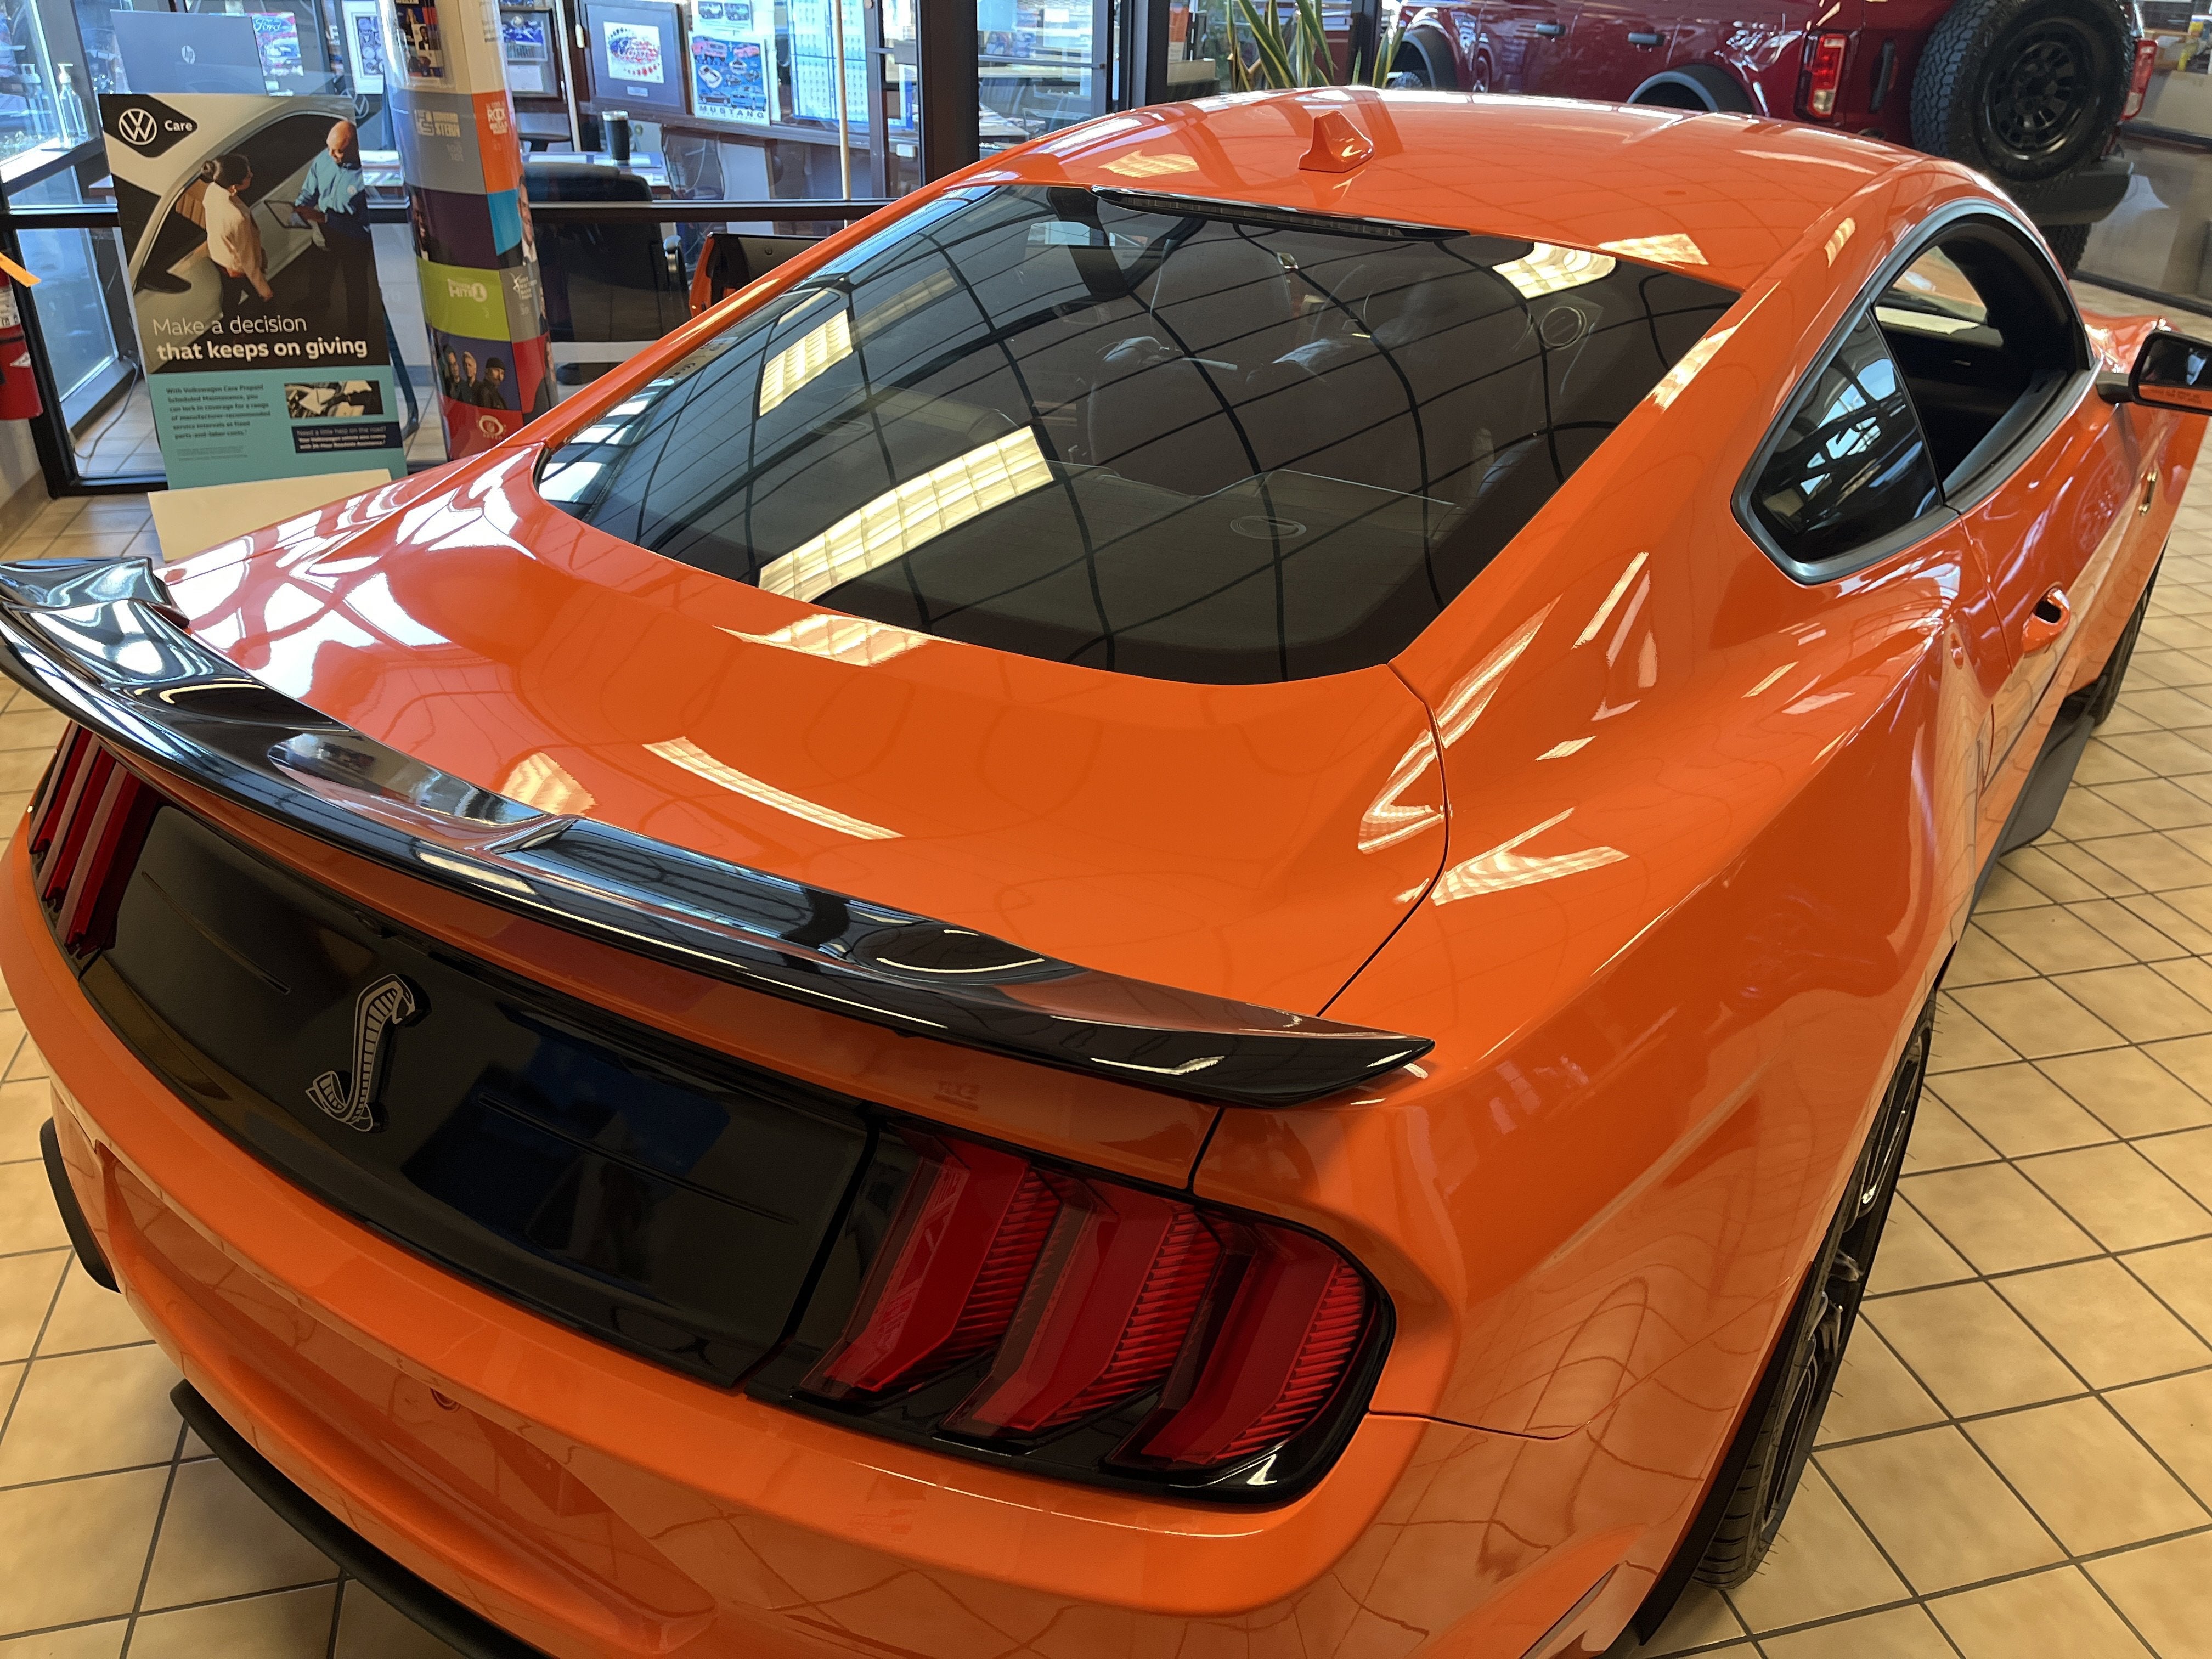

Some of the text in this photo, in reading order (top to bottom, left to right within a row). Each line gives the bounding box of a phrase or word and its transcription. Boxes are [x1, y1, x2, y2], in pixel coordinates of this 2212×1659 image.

[254, 18, 281, 32] Ford
[700, 105, 764, 119] MUSTANG
[165, 120, 193, 132] Care
[153, 315, 307, 336] Make a decision
[157, 336, 368, 362] that keeps on giving
